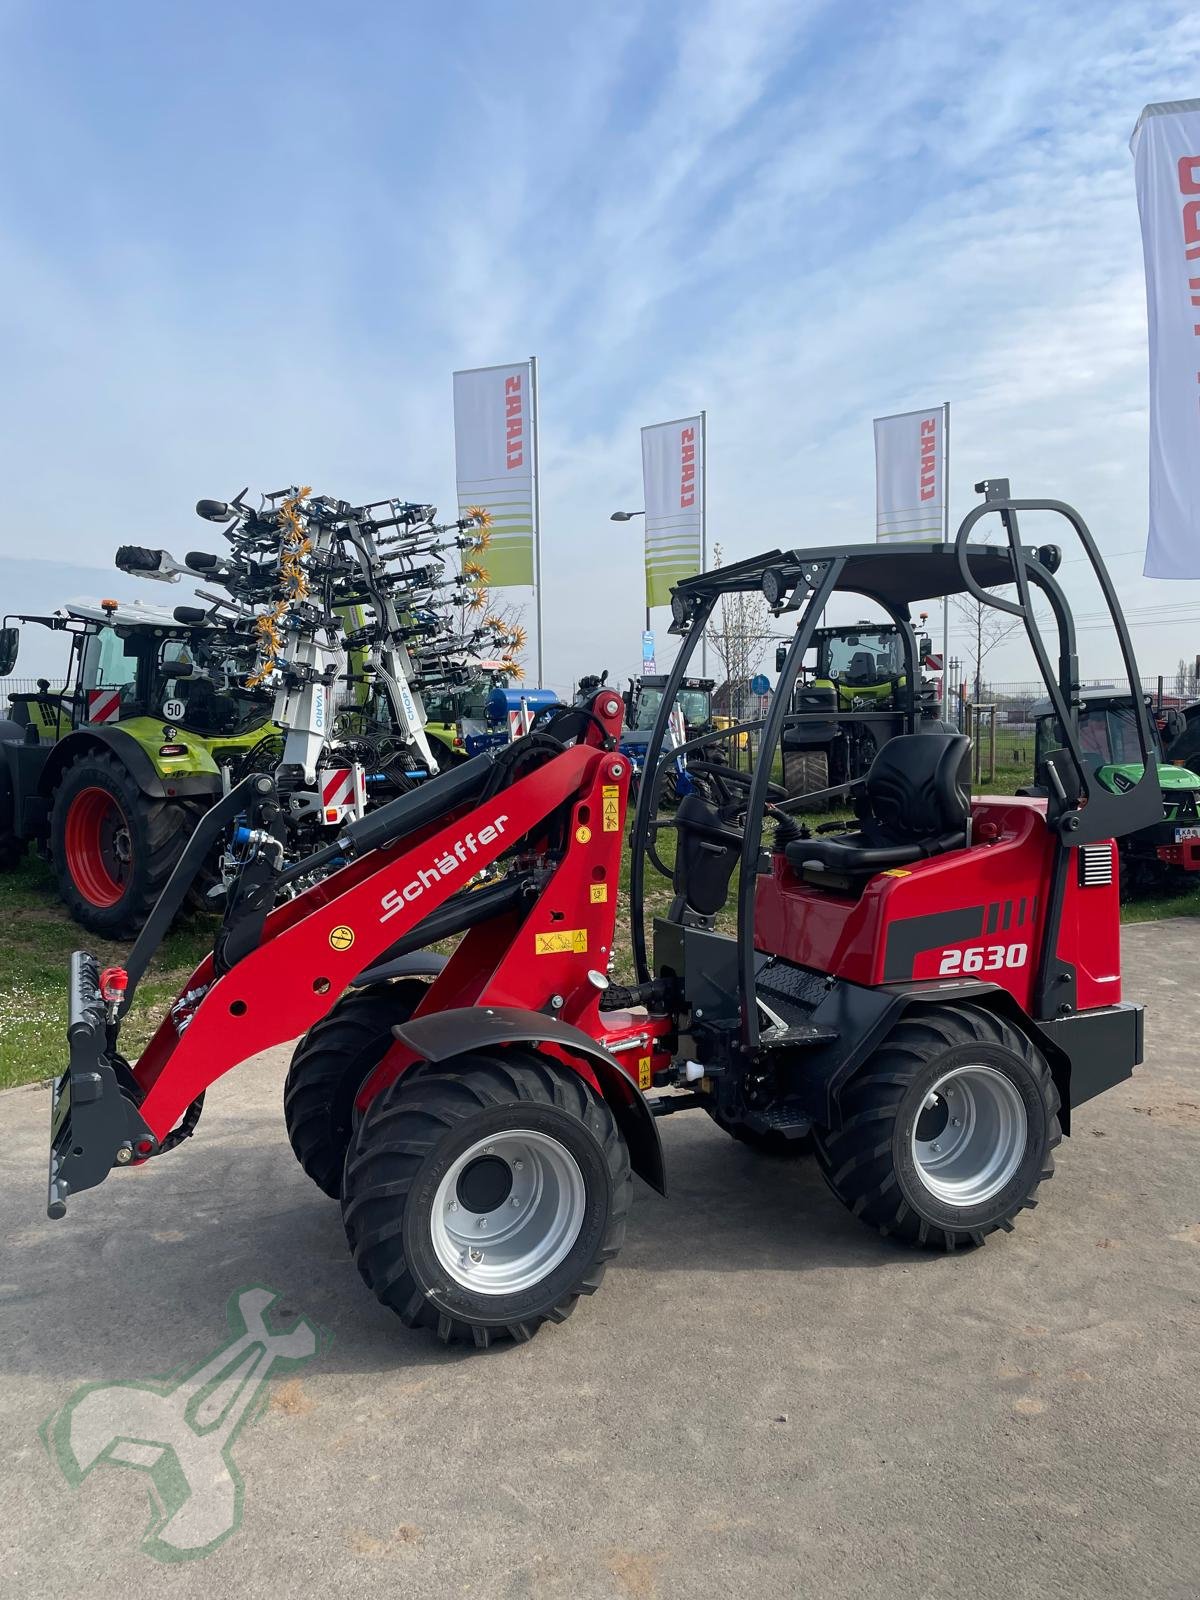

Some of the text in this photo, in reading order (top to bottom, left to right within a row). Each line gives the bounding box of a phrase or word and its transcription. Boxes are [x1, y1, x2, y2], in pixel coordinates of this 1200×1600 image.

[167, 703, 181, 717] 50
[380, 814, 509, 923] Schäffer
[939, 943, 1028, 975] 2630
